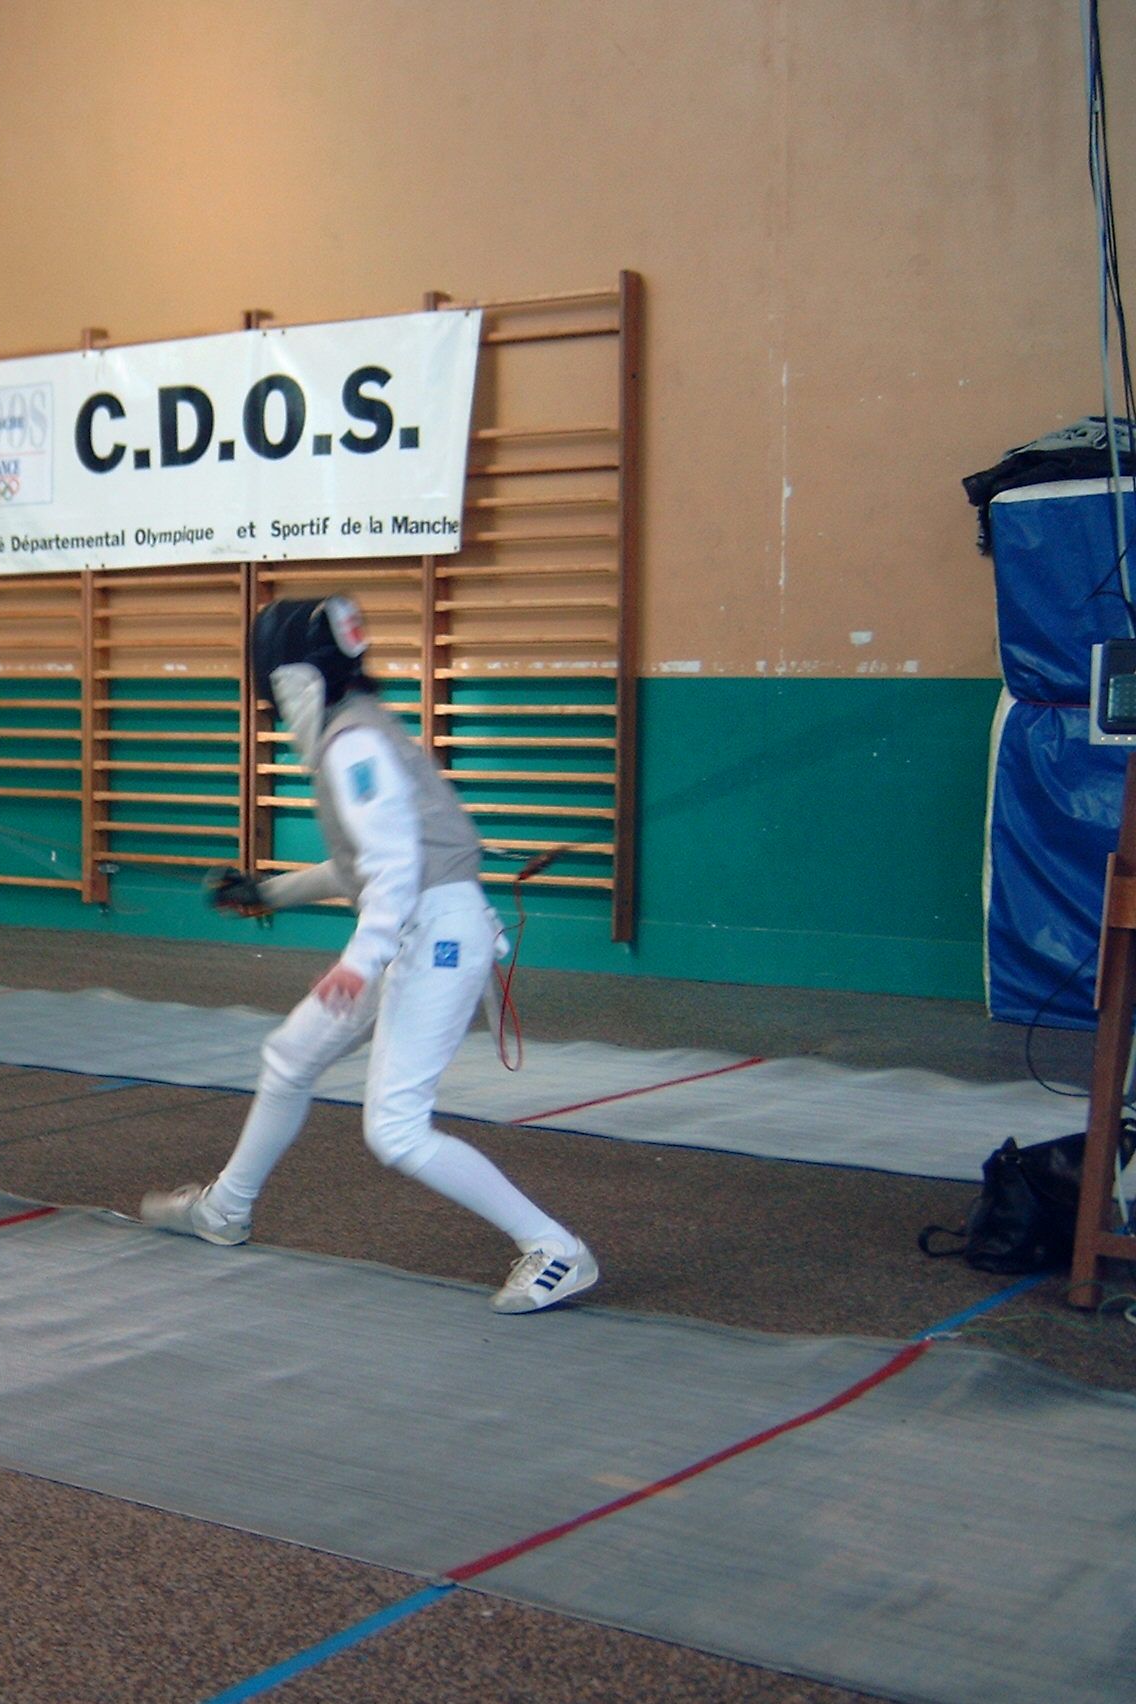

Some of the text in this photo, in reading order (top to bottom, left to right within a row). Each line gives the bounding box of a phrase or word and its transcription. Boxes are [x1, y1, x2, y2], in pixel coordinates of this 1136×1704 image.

[74, 364, 420, 474] C.D.O.S.
[11, 529, 126, 553] Départemental
[134, 525, 215, 546] Olympique
[236, 521, 256, 539] et
[270, 517, 331, 540] Sportif
[341, 516, 362, 535] de
[369, 515, 383, 534] la
[391, 515, 459, 535] Manche
